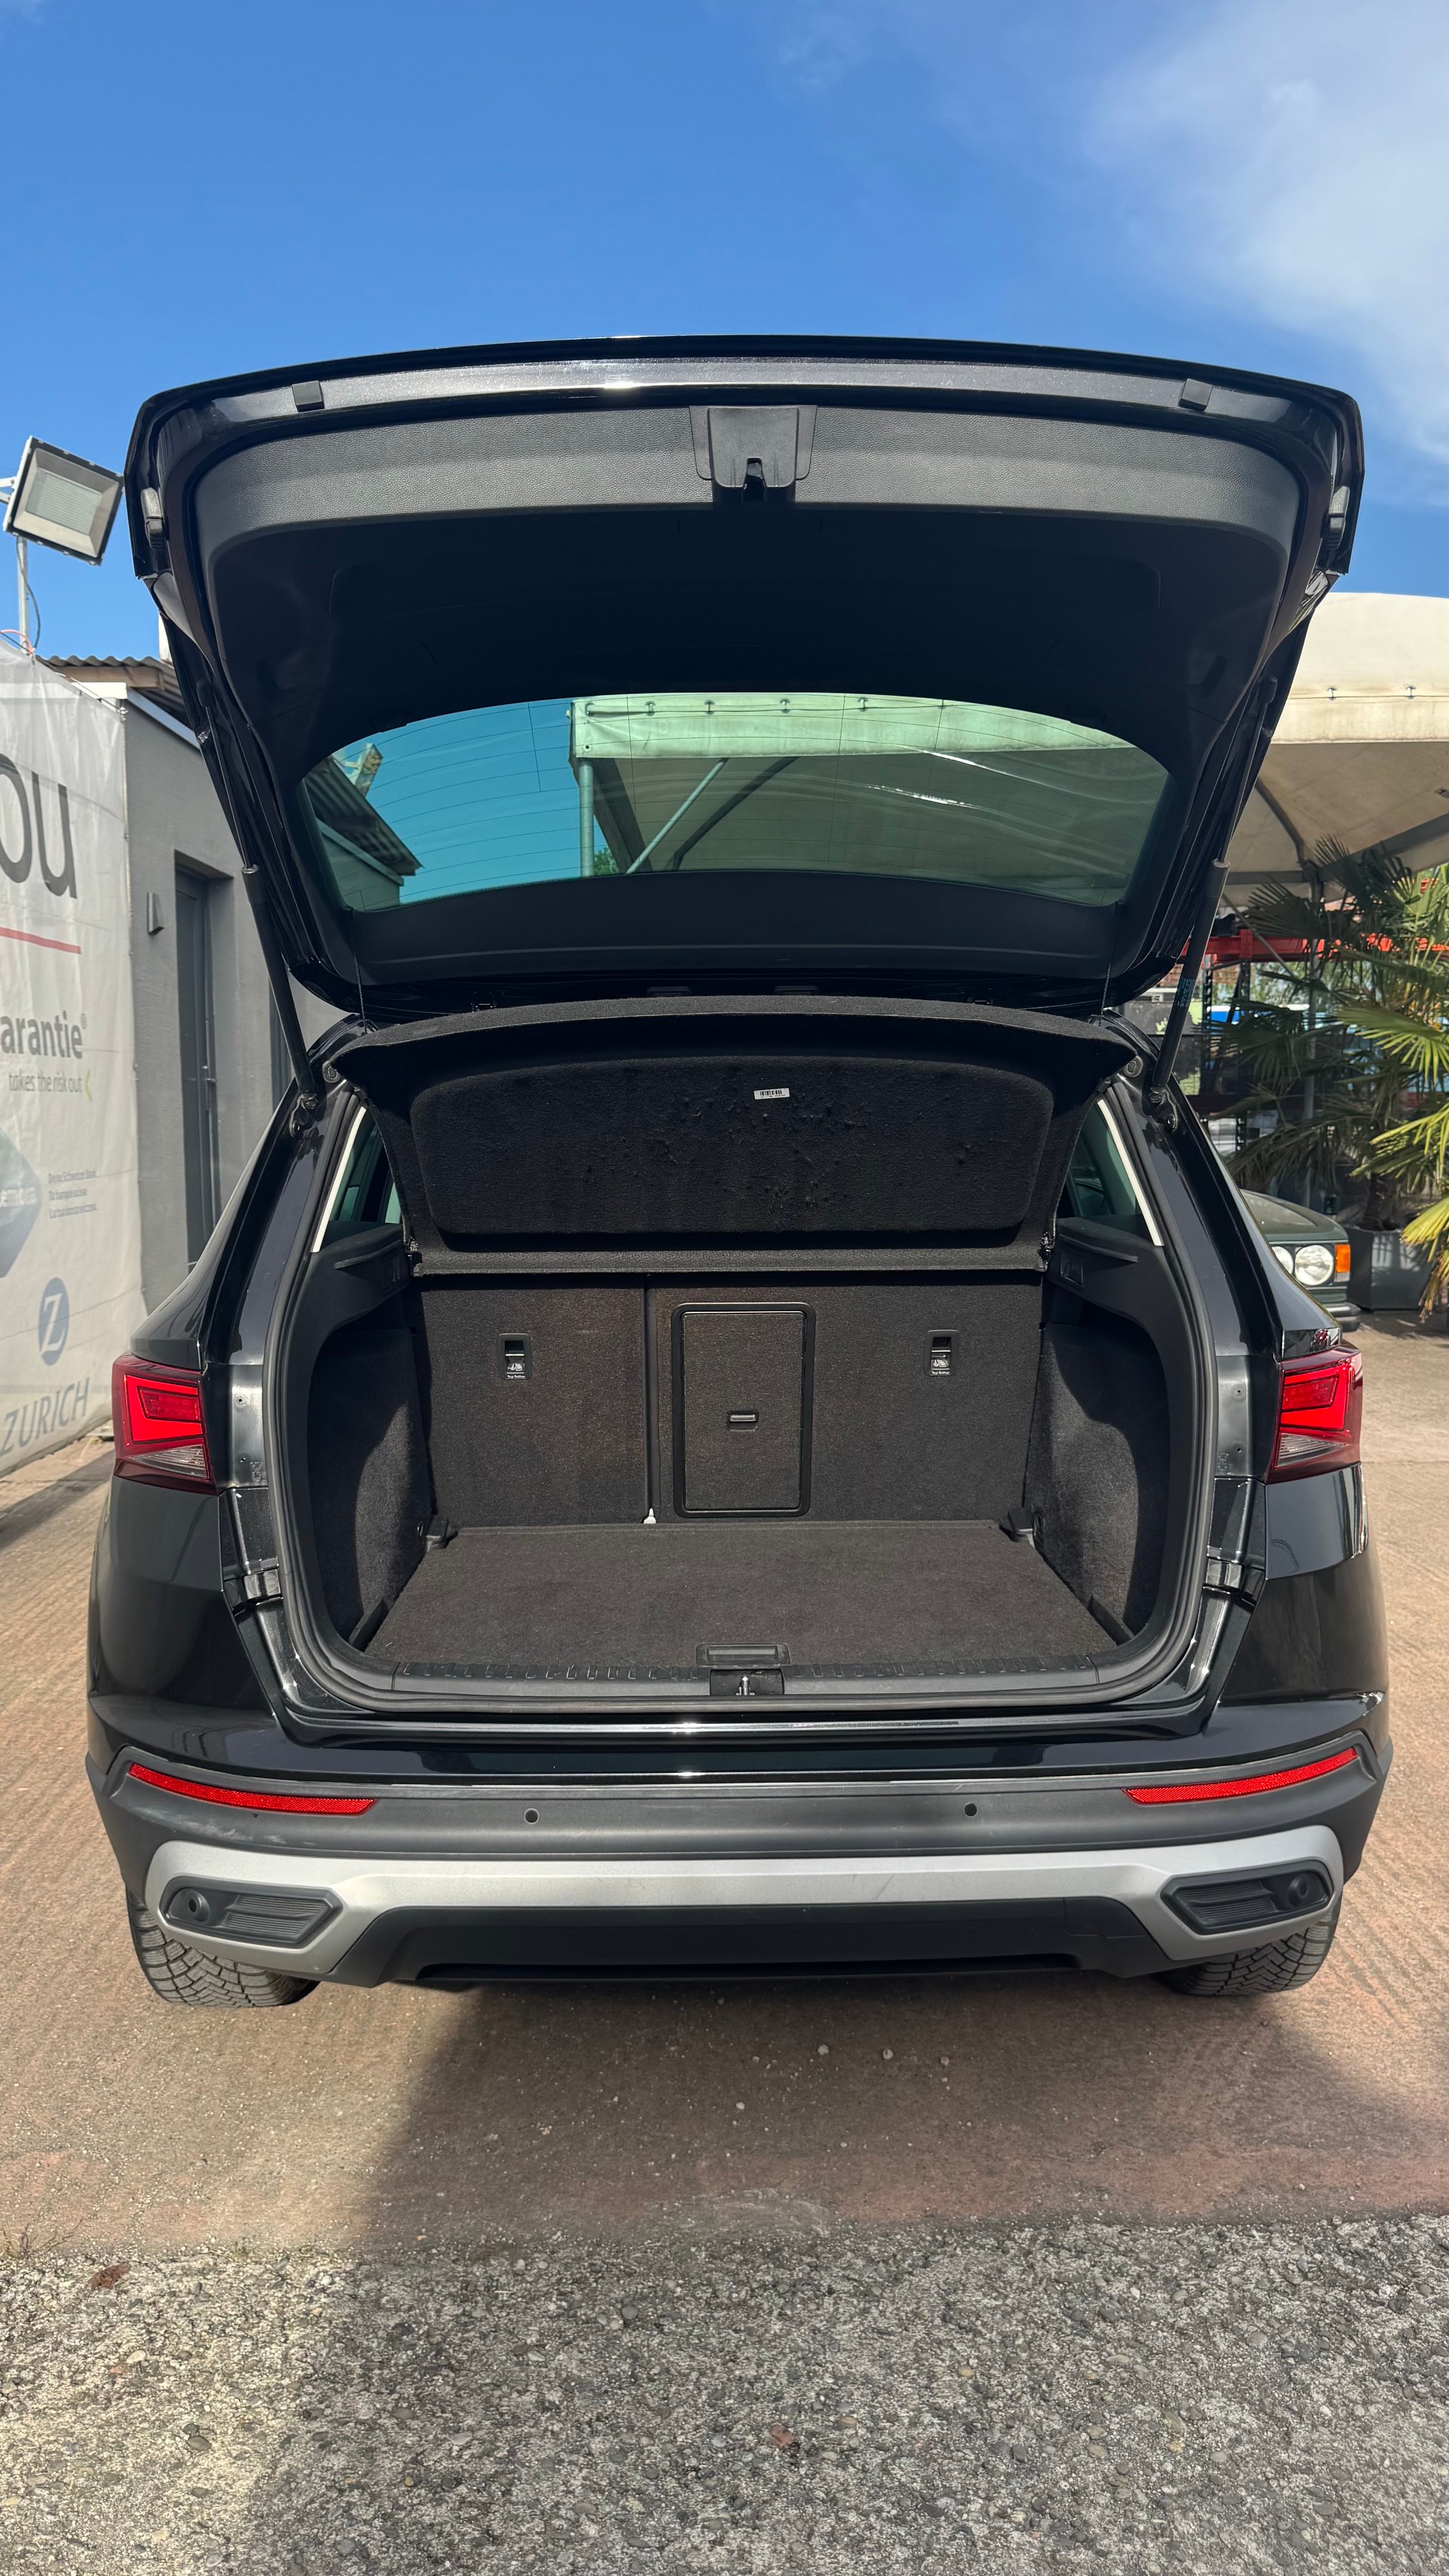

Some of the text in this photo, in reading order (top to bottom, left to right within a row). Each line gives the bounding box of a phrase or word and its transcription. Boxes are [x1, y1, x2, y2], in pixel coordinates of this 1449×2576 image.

[8, 1069, 83, 1094] takes the risk out
[0, 1377, 91, 1457] ZURICH
